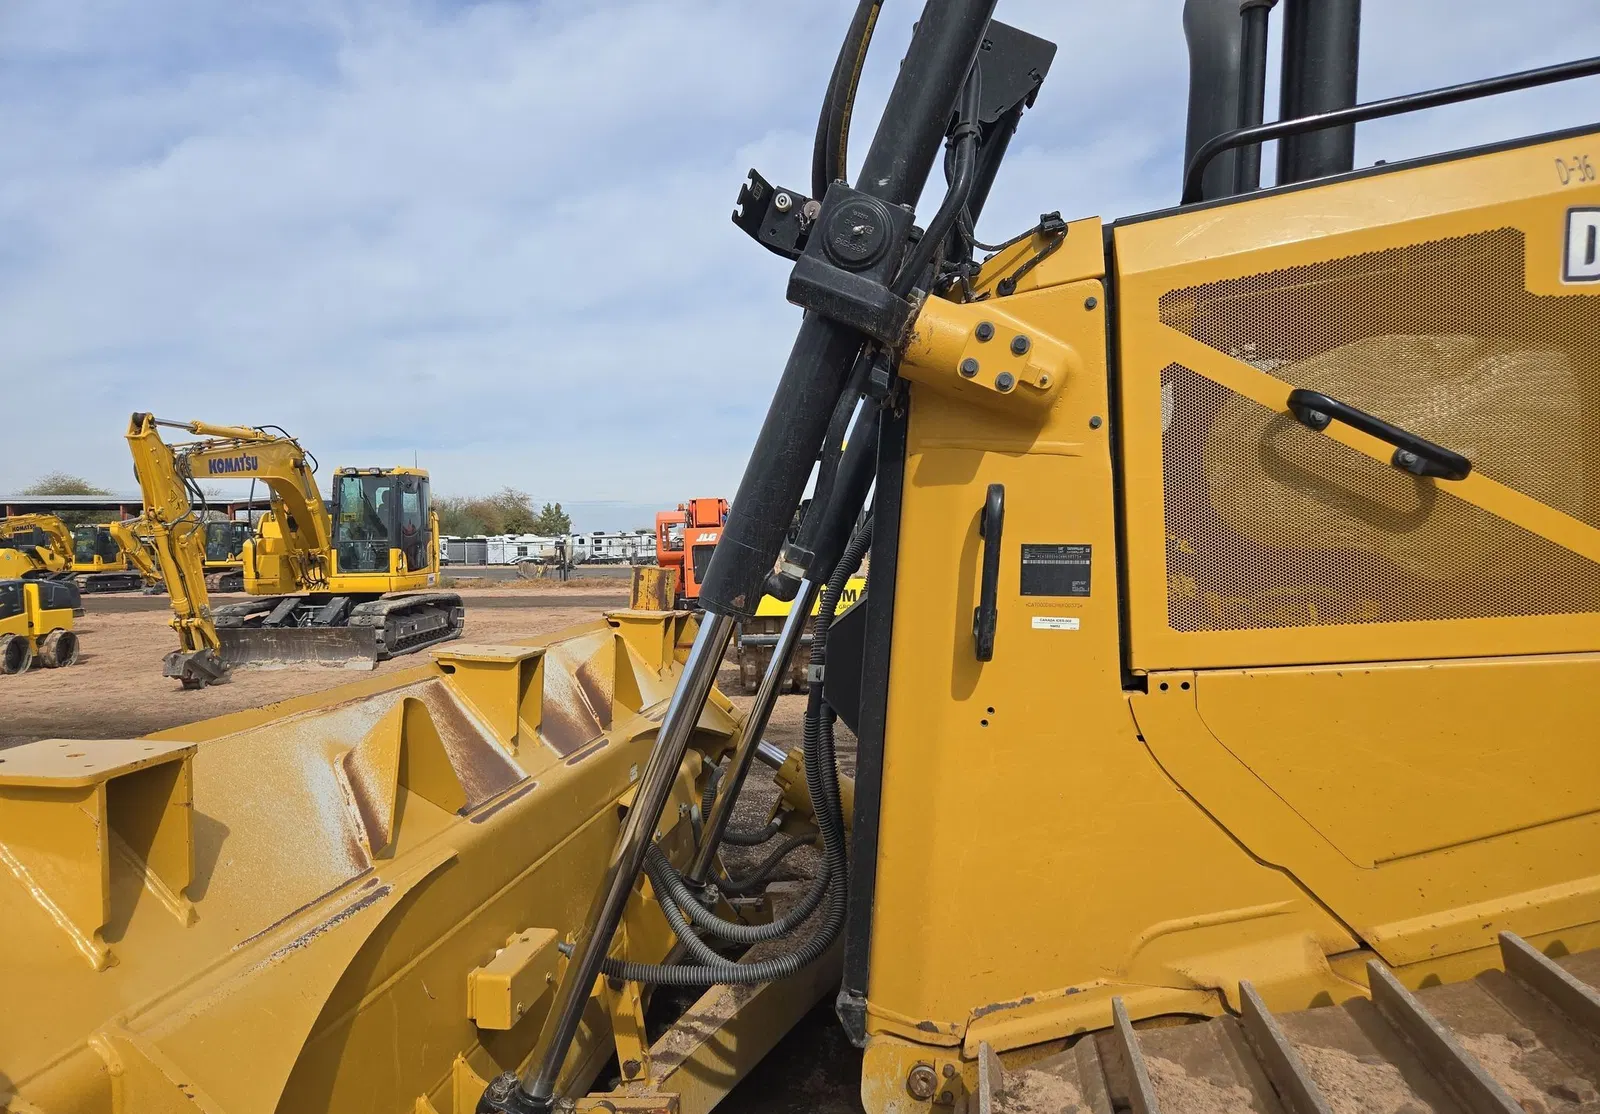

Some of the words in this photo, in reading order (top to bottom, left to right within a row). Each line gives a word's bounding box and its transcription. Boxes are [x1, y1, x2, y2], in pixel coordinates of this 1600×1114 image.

[1555, 154, 1596, 185] D-36
[208, 453, 258, 474] KOMATSU
[12, 524, 36, 532] KOMATSU
[696, 533, 717, 542] JLG
